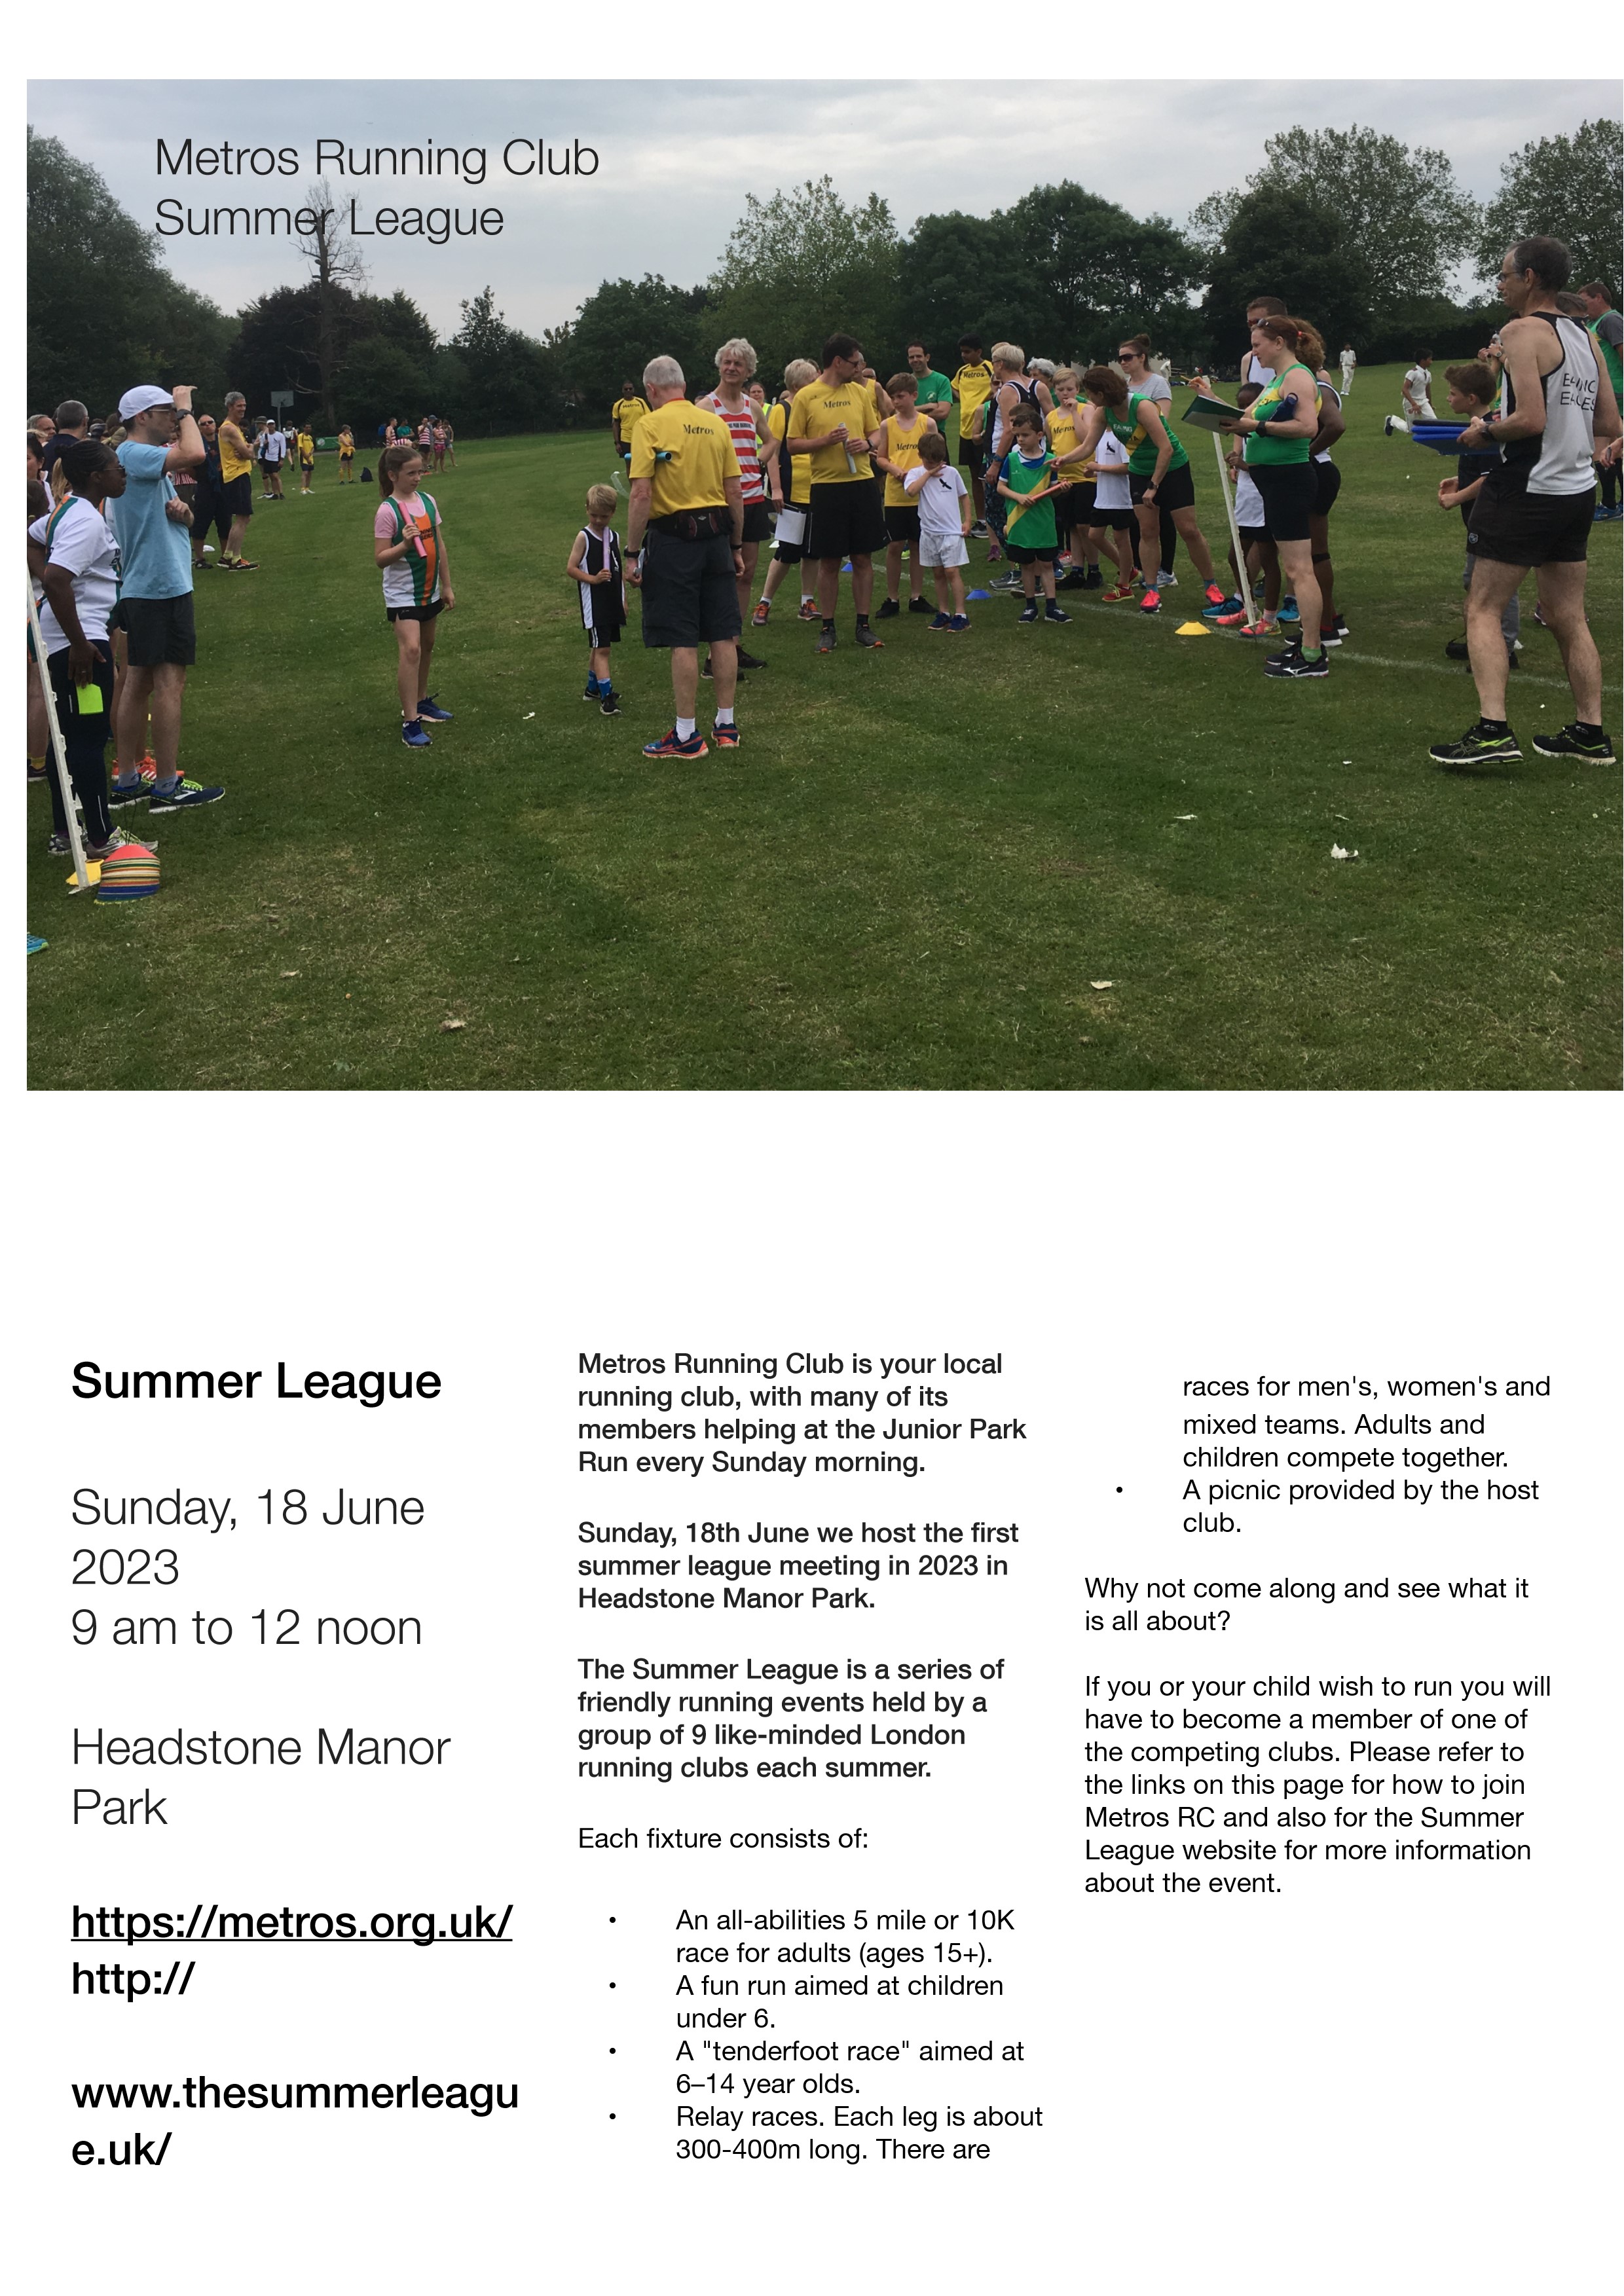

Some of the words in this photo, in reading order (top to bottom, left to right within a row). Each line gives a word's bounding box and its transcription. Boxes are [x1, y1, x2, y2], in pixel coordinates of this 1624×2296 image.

[1562, 373, 1596, 393] EAING
[823, 400, 851, 409] Metros
[1560, 392, 1595, 412] EAGES
[683, 424, 714, 435] Metros
[895, 443, 919, 452] Metro
[580, 1353, 665, 1374] Metros
[675, 1353, 777, 1379] Running
[786, 1353, 843, 1374] Club
[853, 1353, 872, 1374] is
[880, 1358, 936, 1379] your
[945, 1353, 1001, 1374] local
[73, 1362, 262, 1398] Summer
[278, 1362, 441, 1408] League
[1185, 1381, 1249, 1396] races
[1257, 1376, 1290, 1396] for
[1299, 1376, 1377, 1400] men's,
[1388, 1376, 1497, 1396] women's
[1506, 1376, 1549, 1396] and
[580, 1419, 695, 1439] members
[705, 1419, 795, 1444] helping
[804, 1420, 827, 1439] at
[836, 1419, 875, 1439] the
[883, 1419, 962, 1439] Junior
[971, 1419, 1027, 1439] Park
[1185, 1414, 1255, 1434] mixed
[1265, 1415, 1345, 1434] teams.
[1354, 1414, 1431, 1434] Adults
[1441, 1414, 1484, 1434] and
[1184, 1447, 1278, 1467] children
[1287, 1448, 1394, 1472] compete
[1402, 1447, 1507, 1472] together.
[73, 1489, 236, 1533] Sunday,
[259, 1489, 306, 1525] 18
[323, 1489, 424, 1525] June
[1184, 1512, 1240, 1532] club.
[579, 1522, 676, 1548] Sunday,
[687, 1522, 739, 1542] 18th
[748, 1522, 809, 1542] June
[817, 1527, 853, 1542] we
[862, 1522, 915, 1542] host
[923, 1522, 963, 1542] the
[971, 1522, 1018, 1542] first
[73, 1549, 178, 1584] 2023
[580, 1588, 714, 1608] Headstone
[724, 1588, 803, 1608] Manor
[813, 1588, 874, 1608] Park.
[1085, 1578, 1138, 1603] Why
[1148, 1579, 1185, 1597] not
[1194, 1583, 1261, 1597] come
[1270, 1578, 1335, 1603] along
[1344, 1578, 1388, 1597] and
[1398, 1583, 1440, 1597] see
[1449, 1578, 1506, 1597] what
[1517, 1578, 1528, 1597] it
[73, 1609, 96, 1645] 9
[113, 1618, 175, 1645] am
[192, 1611, 232, 1645] to
[252, 1609, 299, 1644] 12
[318, 1618, 420, 1645] noon
[578, 1659, 624, 1679] The
[633, 1658, 739, 1679] Summer
[748, 1659, 838, 1685] League
[847, 1659, 866, 1679] is
[875, 1664, 889, 1679] a
[898, 1659, 972, 1679] series
[980, 1659, 1005, 1679] of
[1087, 1676, 1099, 1696] If
[1107, 1681, 1150, 1701] you
[1160, 1681, 1184, 1696] or
[1192, 1681, 1246, 1701] your
[1253, 1676, 1309, 1696] child
[1319, 1676, 1373, 1696] wish
[1382, 1677, 1405, 1696] to
[1415, 1681, 1451, 1696] run
[1461, 1681, 1504, 1701] you
[1513, 1676, 1549, 1696] will
[75, 1728, 301, 1764] Headstone
[319, 1728, 451, 1764] Manor
[579, 1730, 651, 1750] group
[660, 1724, 684, 1745] of
[692, 1724, 706, 1745] 9
[716, 1724, 860, 1745] like-minded
[872, 1724, 965, 1745] London
[1085, 1741, 1122, 1761] the
[1132, 1741, 1259, 1767] competing
[1269, 1741, 1339, 1761] clubs.
[1351, 1741, 1430, 1761] Please
[1439, 1741, 1493, 1761] refer
[1501, 1743, 1524, 1761] to
[580, 1757, 671, 1783] running
[681, 1757, 748, 1777] clubs
[757, 1757, 816, 1777] each
[826, 1762, 931, 1777] summer.
[75, 1789, 168, 1825] Park
[1086, 1807, 1169, 1827] Metros
[1179, 1807, 1214, 1827] RC
[1224, 1807, 1267, 1827] and
[1278, 1807, 1325, 1827] also
[1335, 1807, 1367, 1827] for
[1375, 1807, 1412, 1827] the
[1422, 1807, 1524, 1827] Summer
[580, 1828, 637, 1848] Each
[647, 1828, 721, 1848] fixture
[730, 1828, 830, 1848] consists
[839, 1828, 867, 1848] of:
[1086, 1872, 1154, 1892] about
[1162, 1872, 1200, 1892] the
[1209, 1874, 1280, 1892] event.
[71, 1904, 513, 1946] https://metros.org.uk/
[676, 1910, 707, 1929] An
[717, 1910, 845, 1929] all-abilities
[854, 1910, 867, 1929] 5
[877, 1910, 925, 1929] mile
[934, 1915, 959, 1929] or
[969, 1910, 1014, 1929] 10K
[73, 1961, 196, 2002] http://
[676, 1975, 694, 1995] A
[701, 1975, 738, 1995] fun
[748, 1980, 785, 1995] run
[795, 1975, 867, 1995] aimed
[877, 1977, 899, 1995] at
[908, 1975, 1003, 1995] children
[678, 2008, 747, 2028] under
[754, 2009, 774, 2028] 6.
[676, 2041, 693, 2060] A
[704, 2041, 838, 2060] "tenderfoot
[848, 2041, 908, 2060] race"
[920, 2041, 992, 2060] aimed
[1003, 2042, 1024, 2060] at
[71, 2076, 517, 2117] www.thesummerleagu
[743, 2079, 795, 2098] year
[803, 2073, 859, 2093] olds.
[678, 2106, 743, 2131] Relay
[753, 2111, 823, 2126] races.
[835, 2106, 893, 2126] Each
[904, 2106, 936, 2132] leg
[948, 2106, 965, 2126] is
[974, 2106, 1043, 2126] about
[73, 2132, 172, 2165] e.uk/
[676, 2139, 800, 2159] 300-400m
[810, 2139, 866, 2164] long.
[876, 2139, 944, 2159] There
[953, 2144, 990, 2159] are
